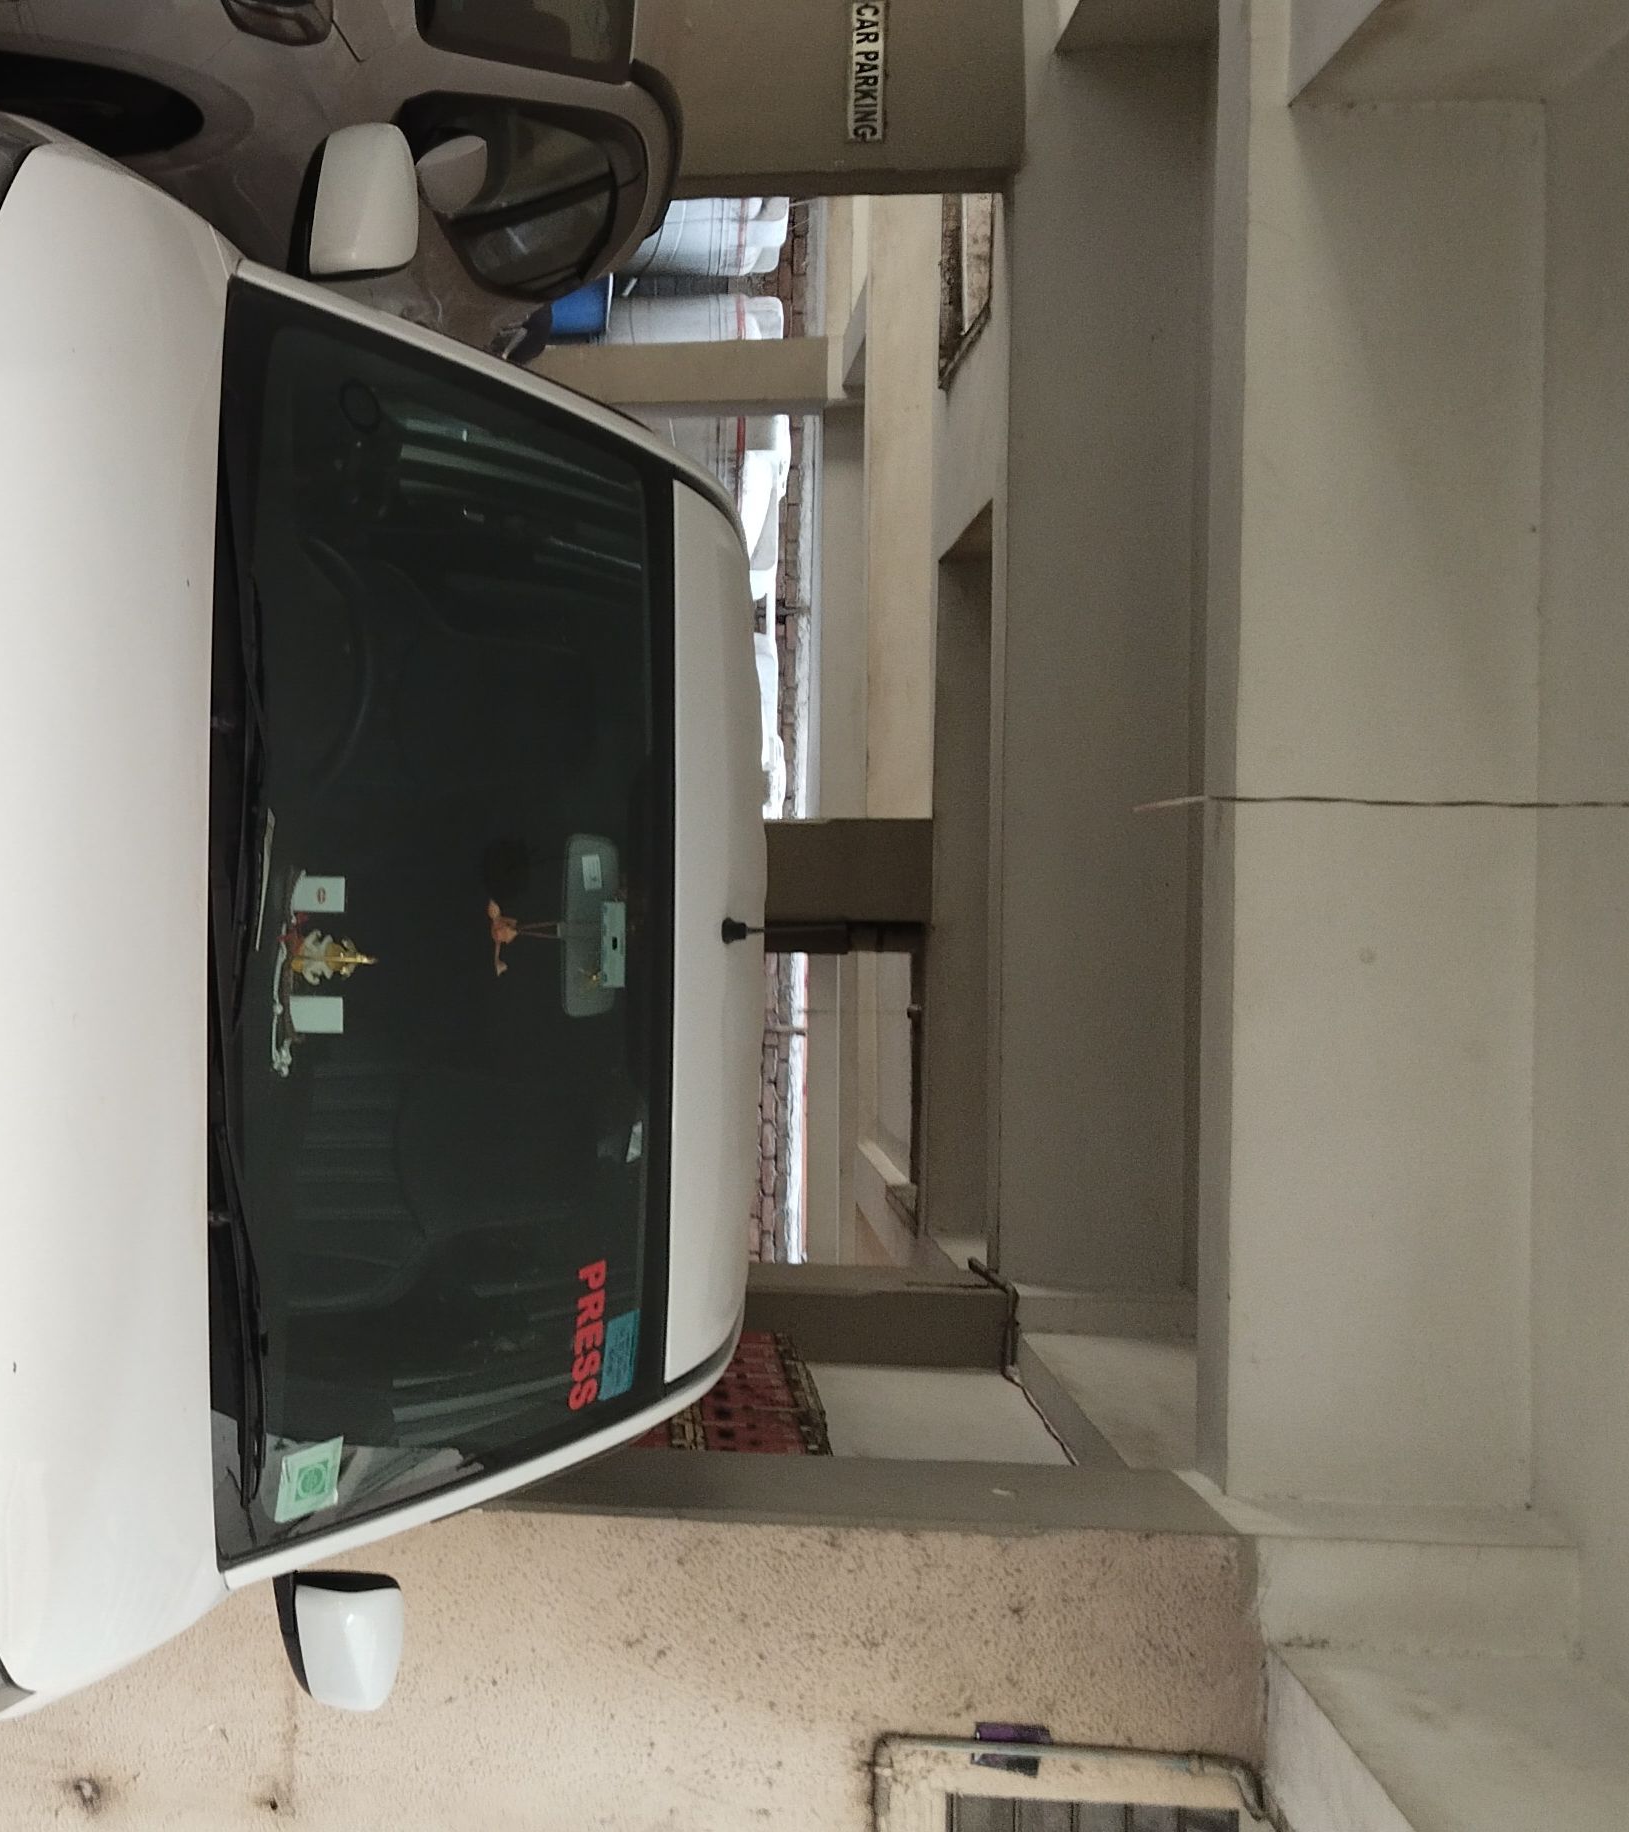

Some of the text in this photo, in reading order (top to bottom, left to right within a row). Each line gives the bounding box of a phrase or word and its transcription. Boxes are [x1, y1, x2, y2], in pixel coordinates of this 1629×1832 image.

[853, 3, 878, 143] CAR PARKING
[568, 1259, 606, 1411] PRESS
